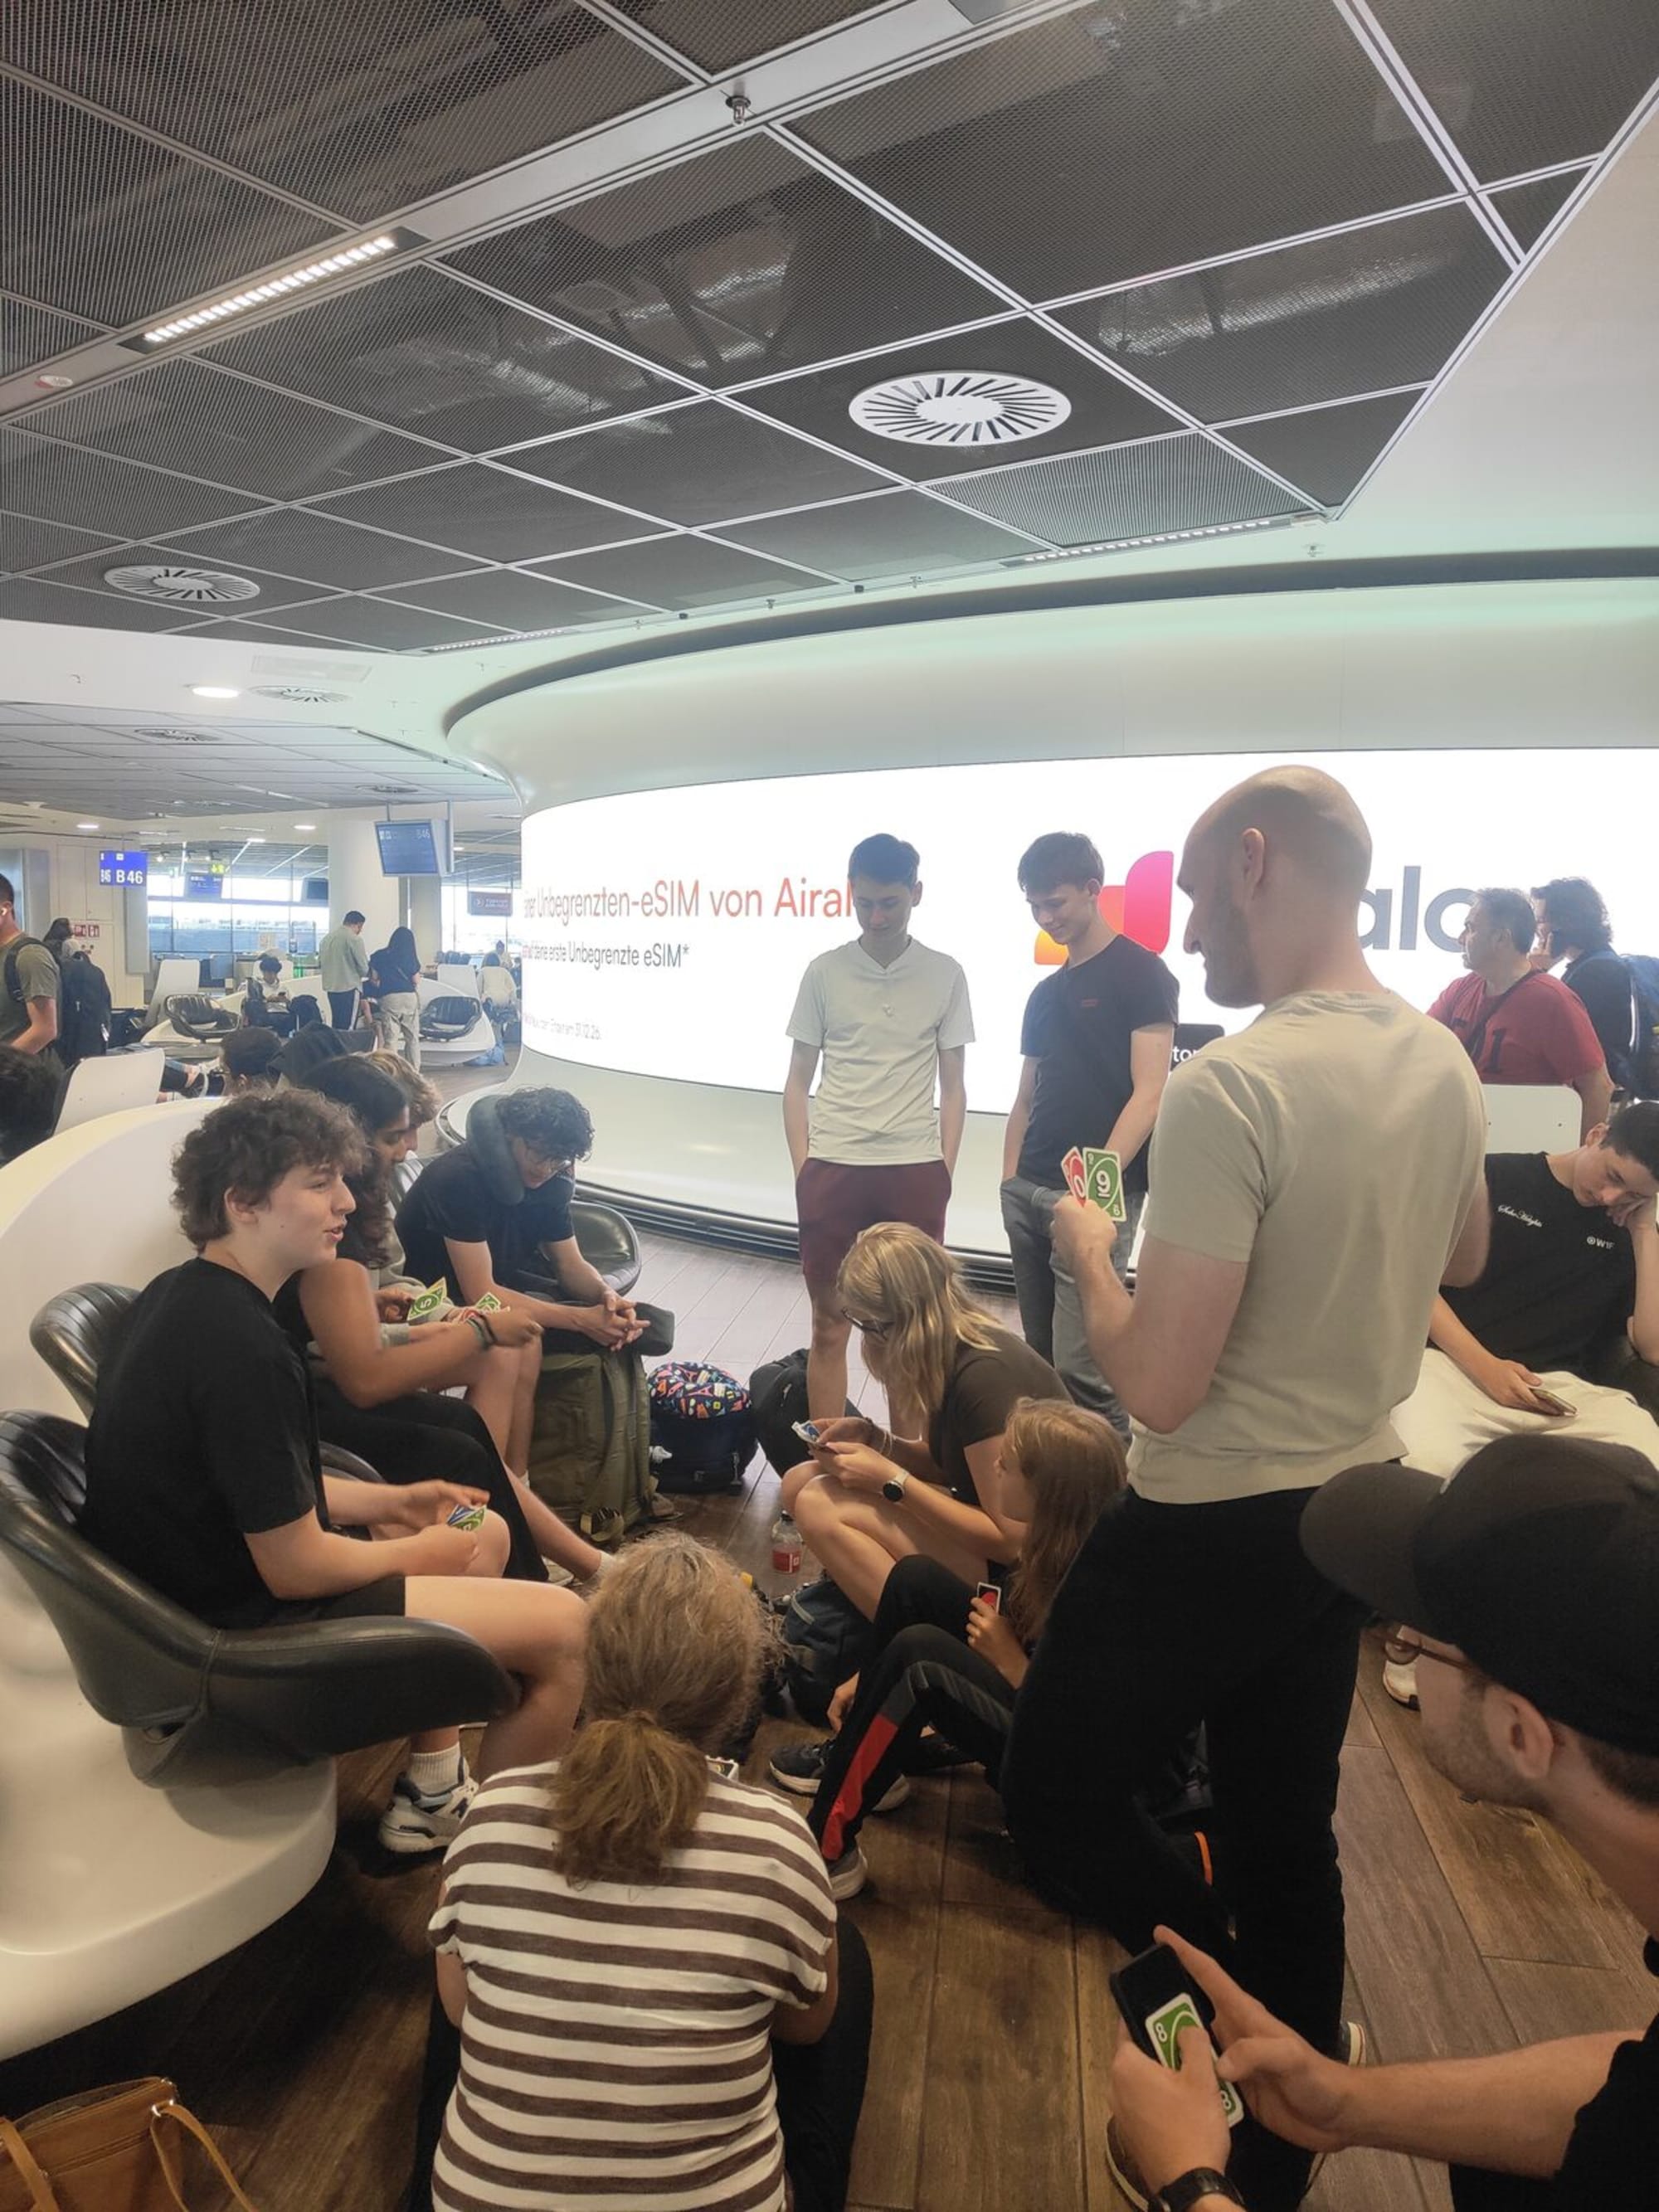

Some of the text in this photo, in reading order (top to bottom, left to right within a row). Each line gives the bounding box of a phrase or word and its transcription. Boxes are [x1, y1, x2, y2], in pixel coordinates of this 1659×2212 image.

[537, 879, 699, 927] Unbegrenzten-eSIM
[710, 890, 762, 917] von
[567, 940, 640, 971] Unbegrenzte
[1096, 1169, 1112, 1198] 9
[1155, 2022, 1168, 2043] 8
